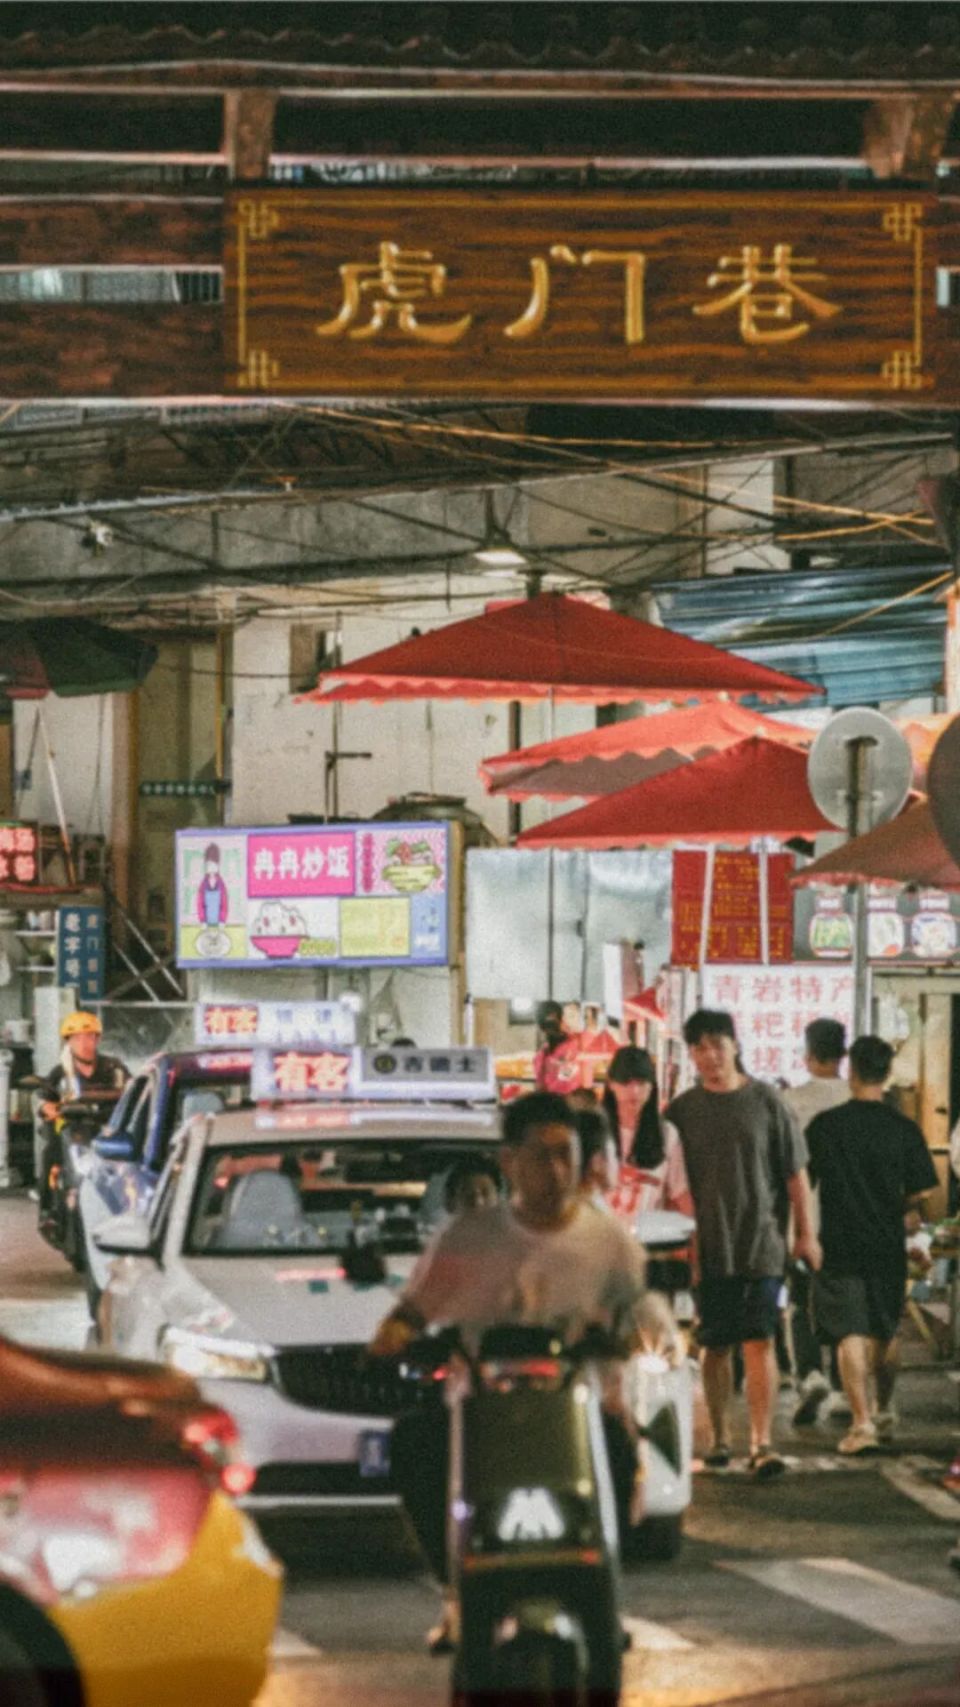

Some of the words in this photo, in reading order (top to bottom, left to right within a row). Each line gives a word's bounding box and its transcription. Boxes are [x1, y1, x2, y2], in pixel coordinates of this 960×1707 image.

[317, 242, 838, 344] 虎门巷
[254, 847, 350, 880] 冉冉炒饭
[274, 1052, 350, 1091] 有客
